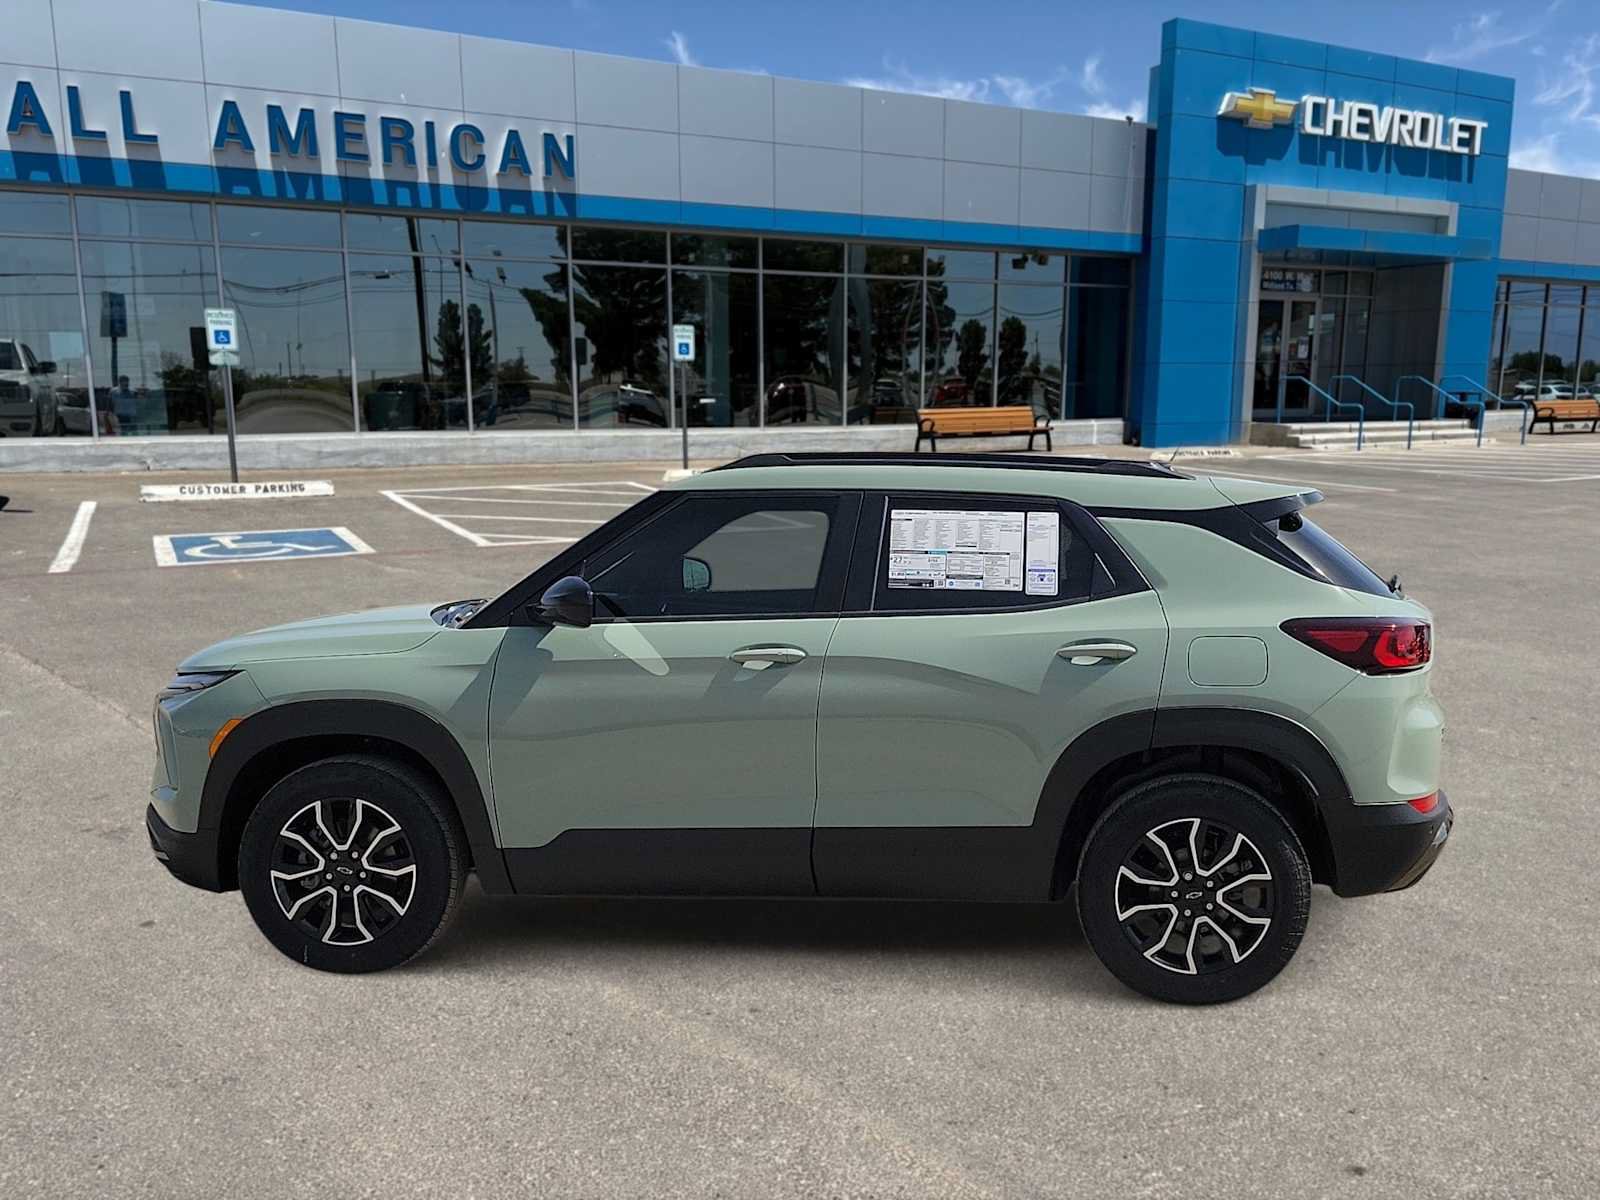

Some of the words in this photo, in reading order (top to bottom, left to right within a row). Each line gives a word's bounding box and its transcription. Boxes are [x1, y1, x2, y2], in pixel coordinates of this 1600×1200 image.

[7, 80, 158, 145] ALL
[213, 99, 576, 180] AMERICAN
[1301, 94, 1488, 156] CHEVROLET
[179, 485, 247, 495] CUSTOMER
[254, 483, 305, 494] PARKING
